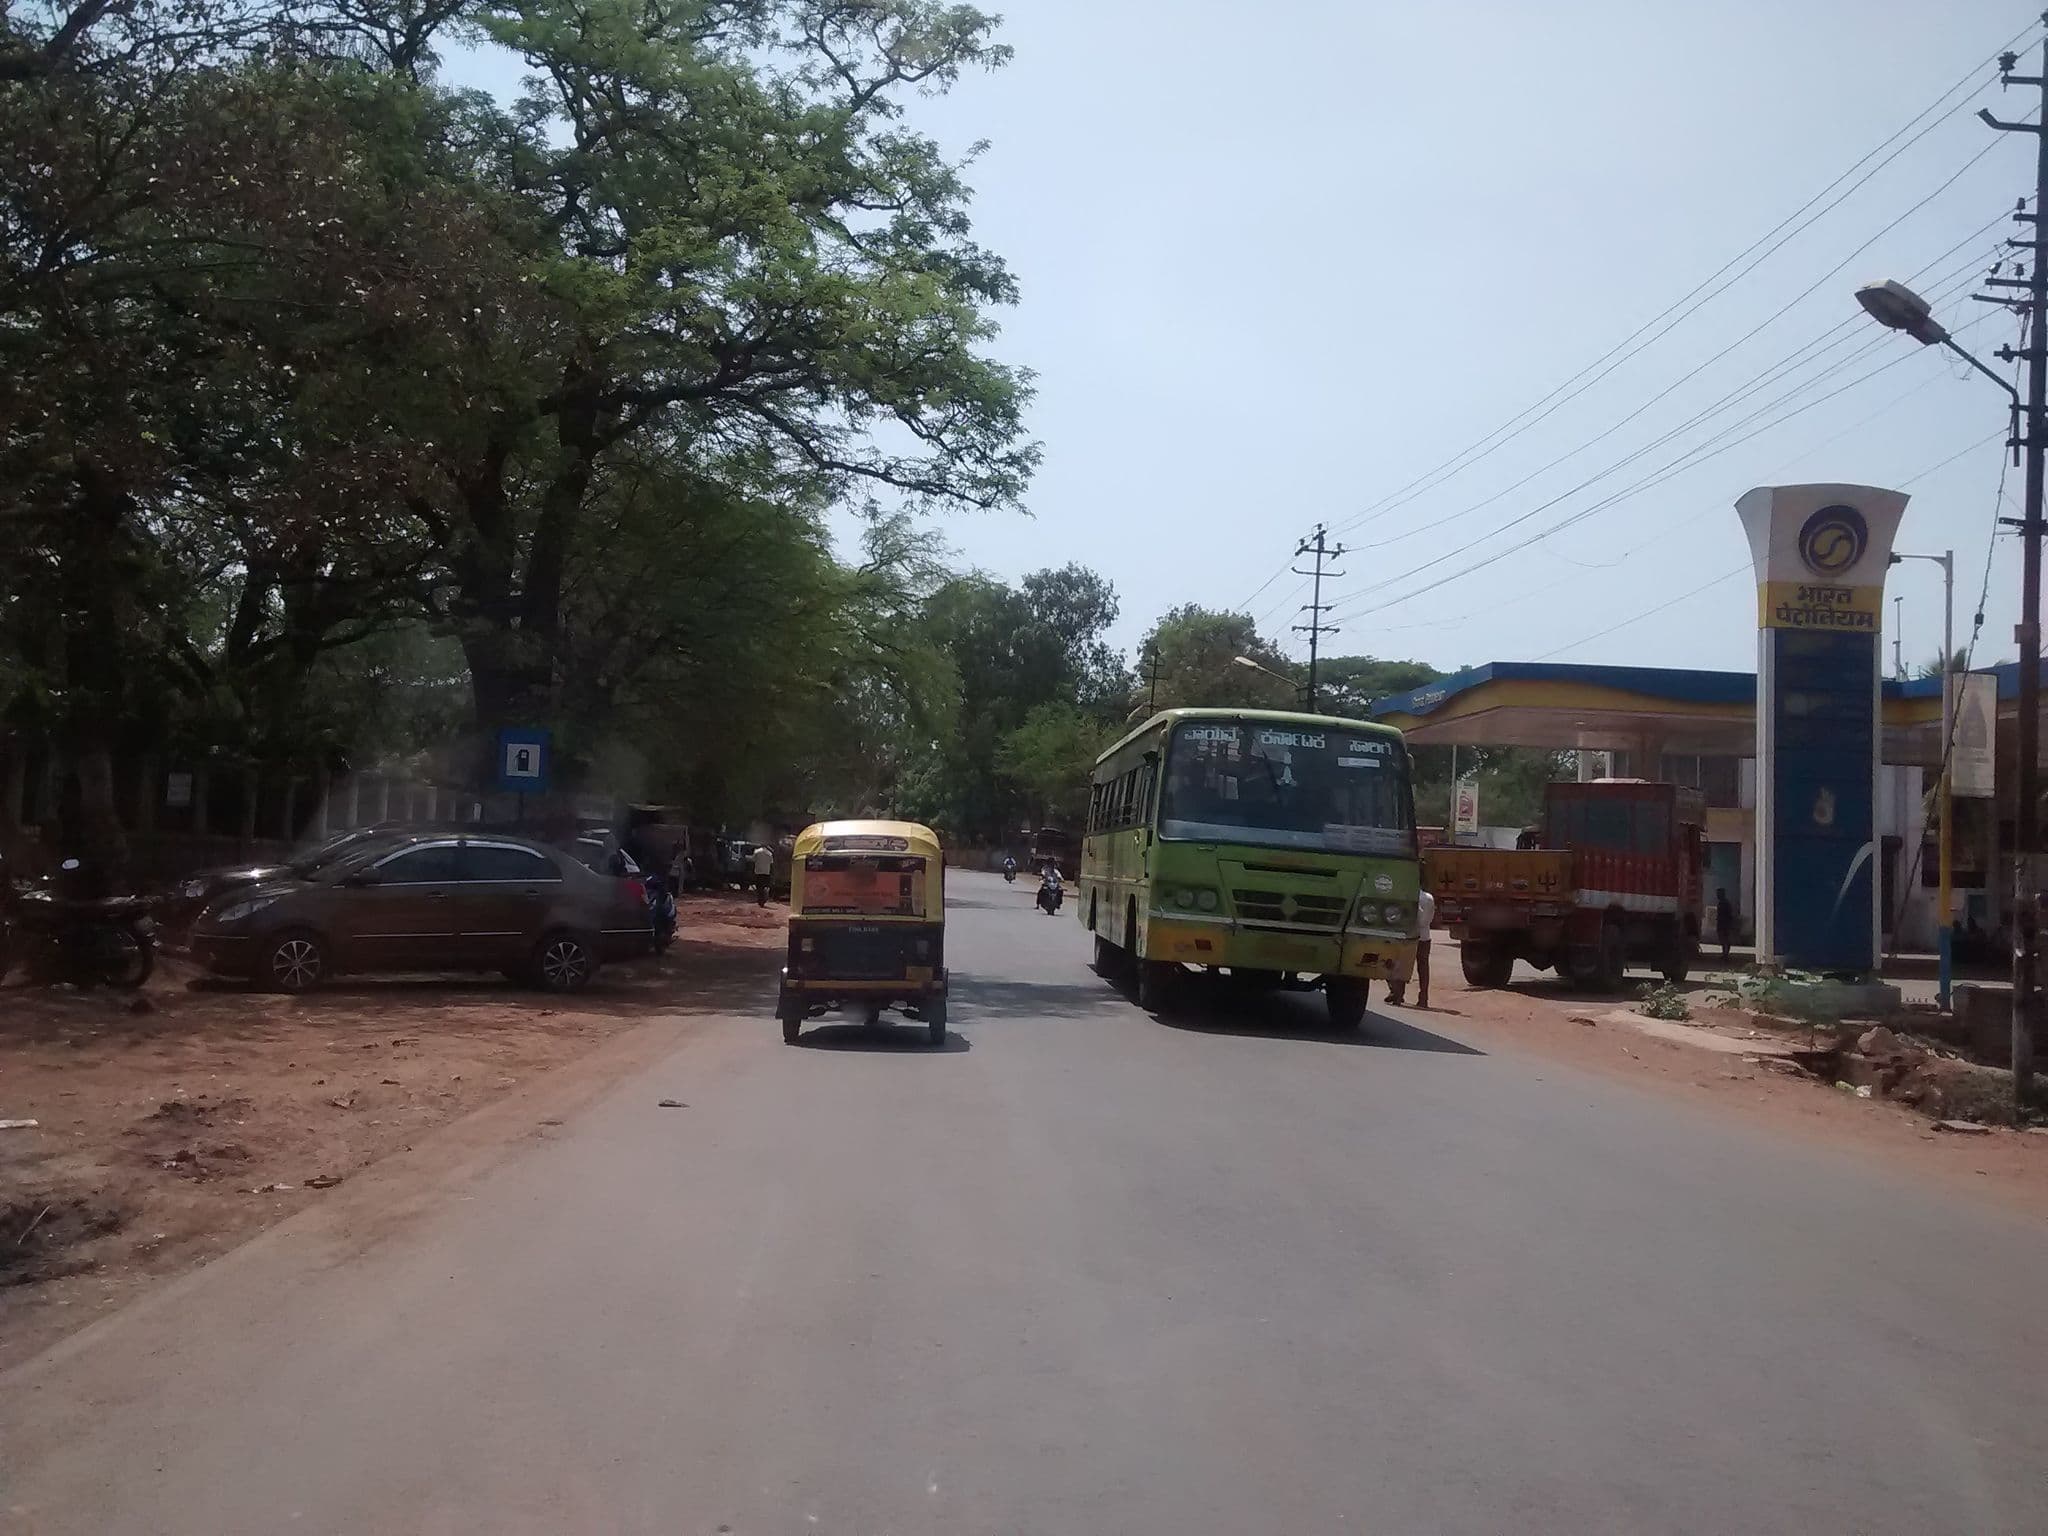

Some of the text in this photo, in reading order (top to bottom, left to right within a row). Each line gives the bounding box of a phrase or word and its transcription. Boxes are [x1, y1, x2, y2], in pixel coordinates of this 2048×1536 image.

[1798, 585, 1852, 604] भारत
[1775, 601, 1875, 627] पेट्रोलियम
[1261, 728, 1326, 749] ಕರ್ನಾಟಕ
